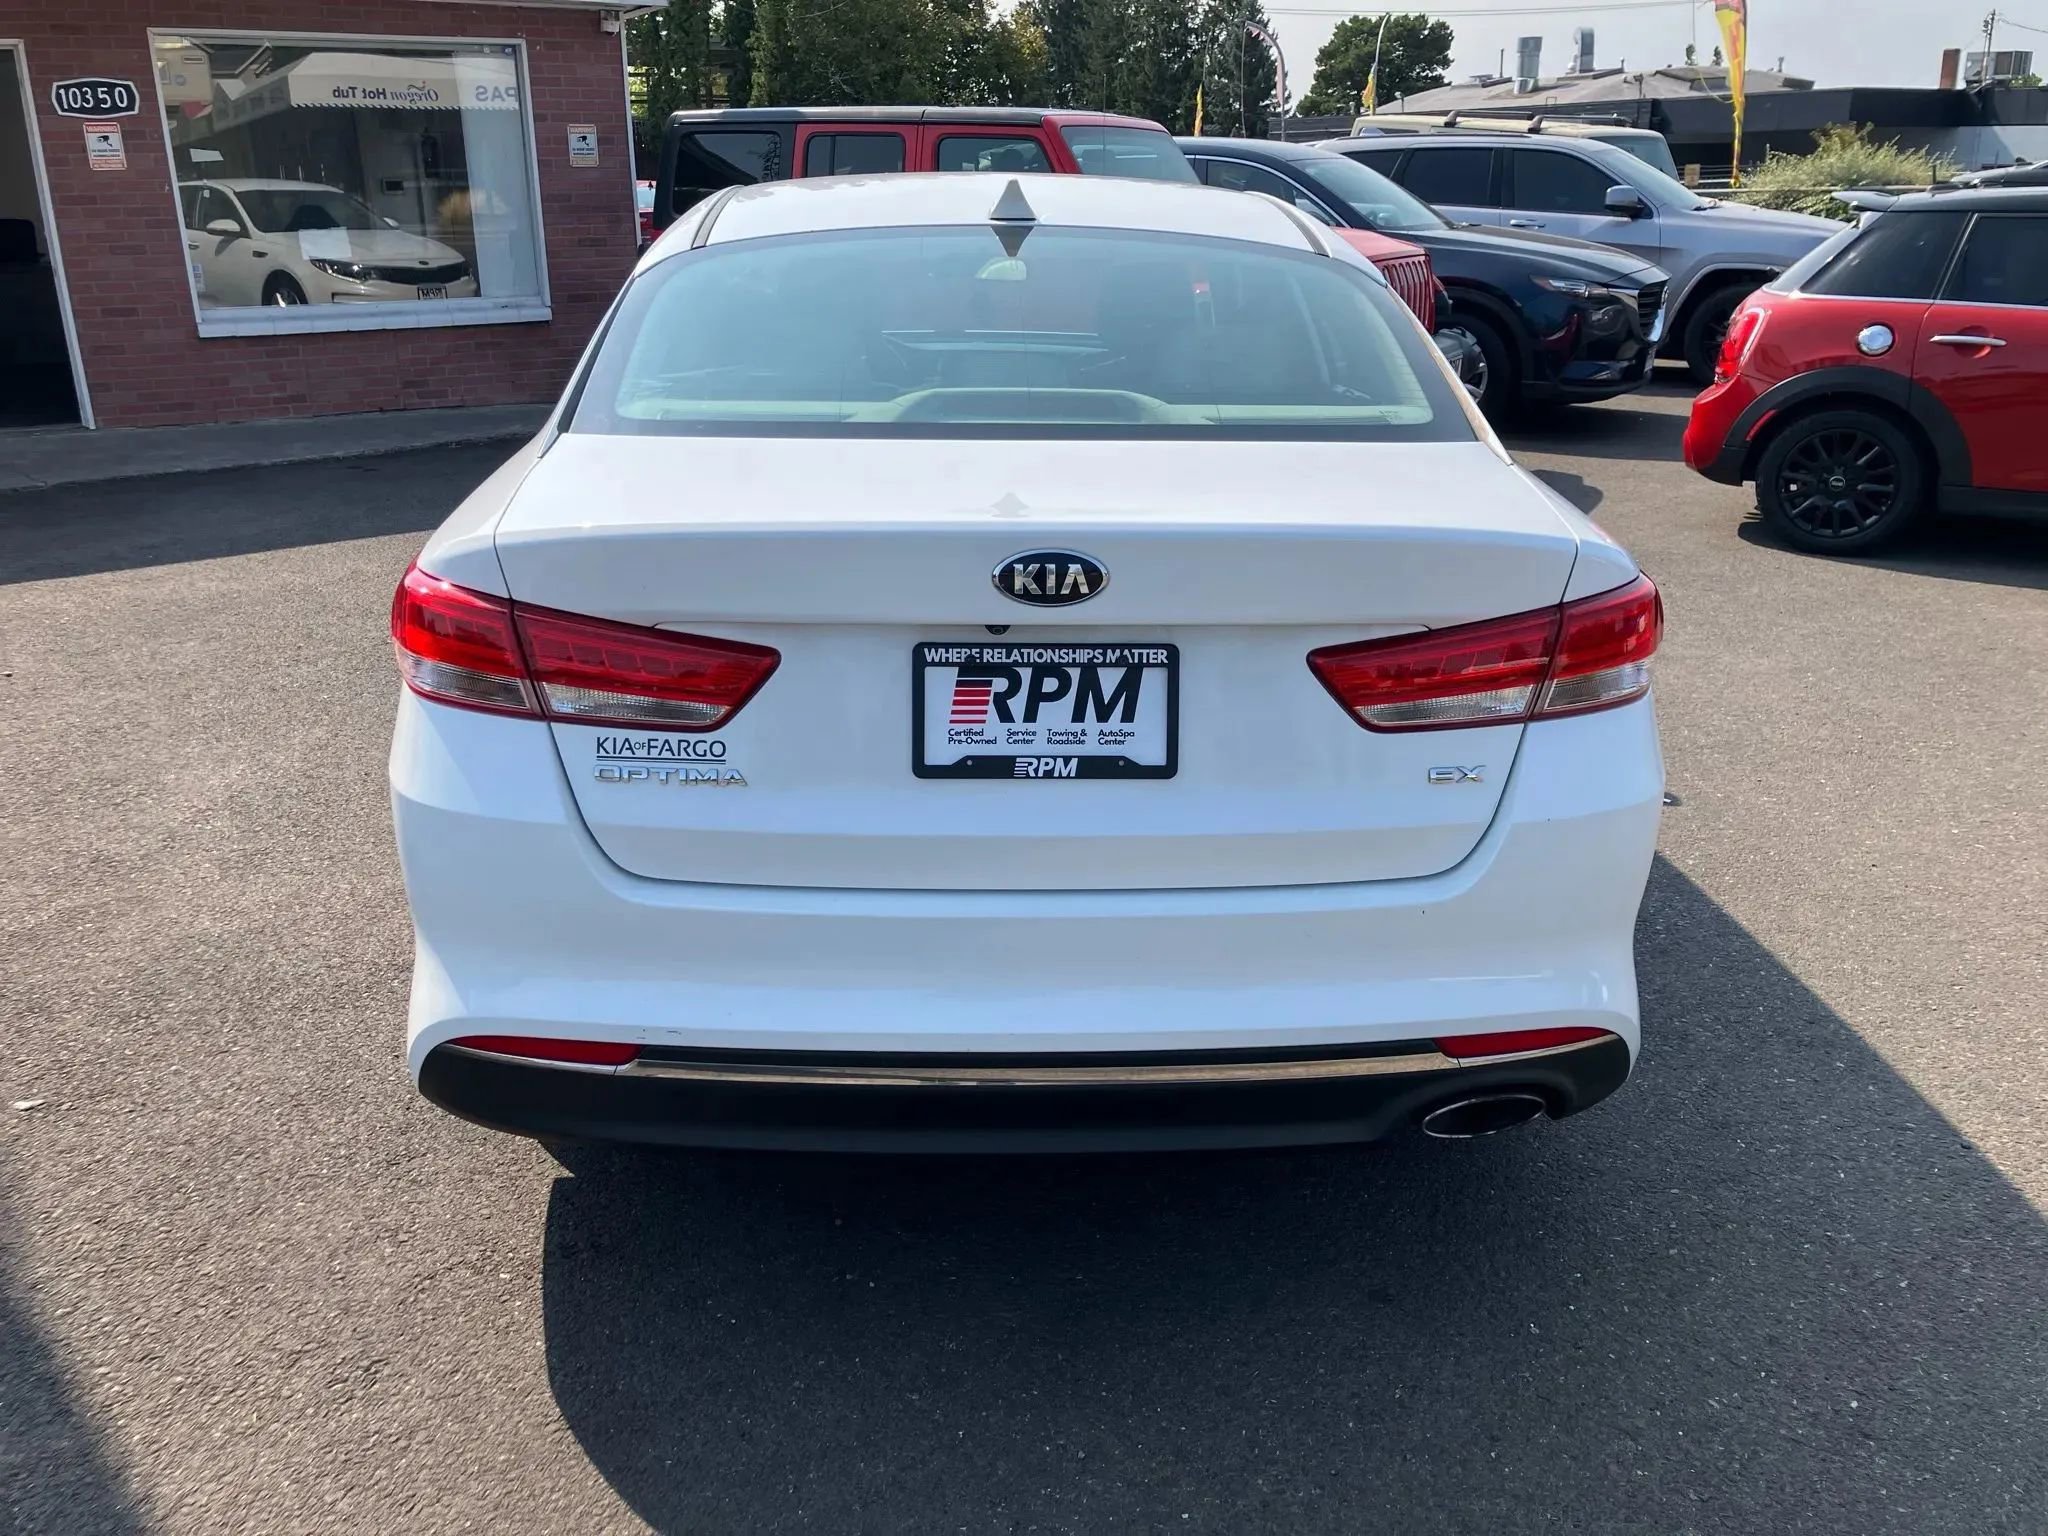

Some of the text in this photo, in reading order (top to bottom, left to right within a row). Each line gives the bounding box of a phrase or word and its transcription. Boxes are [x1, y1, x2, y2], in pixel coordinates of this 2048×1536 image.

[58, 86, 128, 110] 10350
[1012, 563, 1090, 595] KIA
[982, 648, 1103, 664] RELATIONSHIPS
[1105, 649, 1169, 664] MATTER
[949, 665, 1145, 724] RPM
[948, 728, 984, 737] Certified
[1006, 728, 1037, 737] Service
[1047, 728, 1088, 740] Towing &
[1098, 728, 1135, 740] AutoSpa
[596, 736, 727, 758] KIA OF FARGO
[948, 736, 997, 745] Pre-Owned
[1006, 736, 1035, 745] Center
[1047, 737, 1087, 746] Roadside
[1098, 737, 1127, 746] Center
[1013, 757, 1079, 778] RPM
[594, 764, 748, 787] OPTIMA
[1428, 765, 1487, 785] EX
